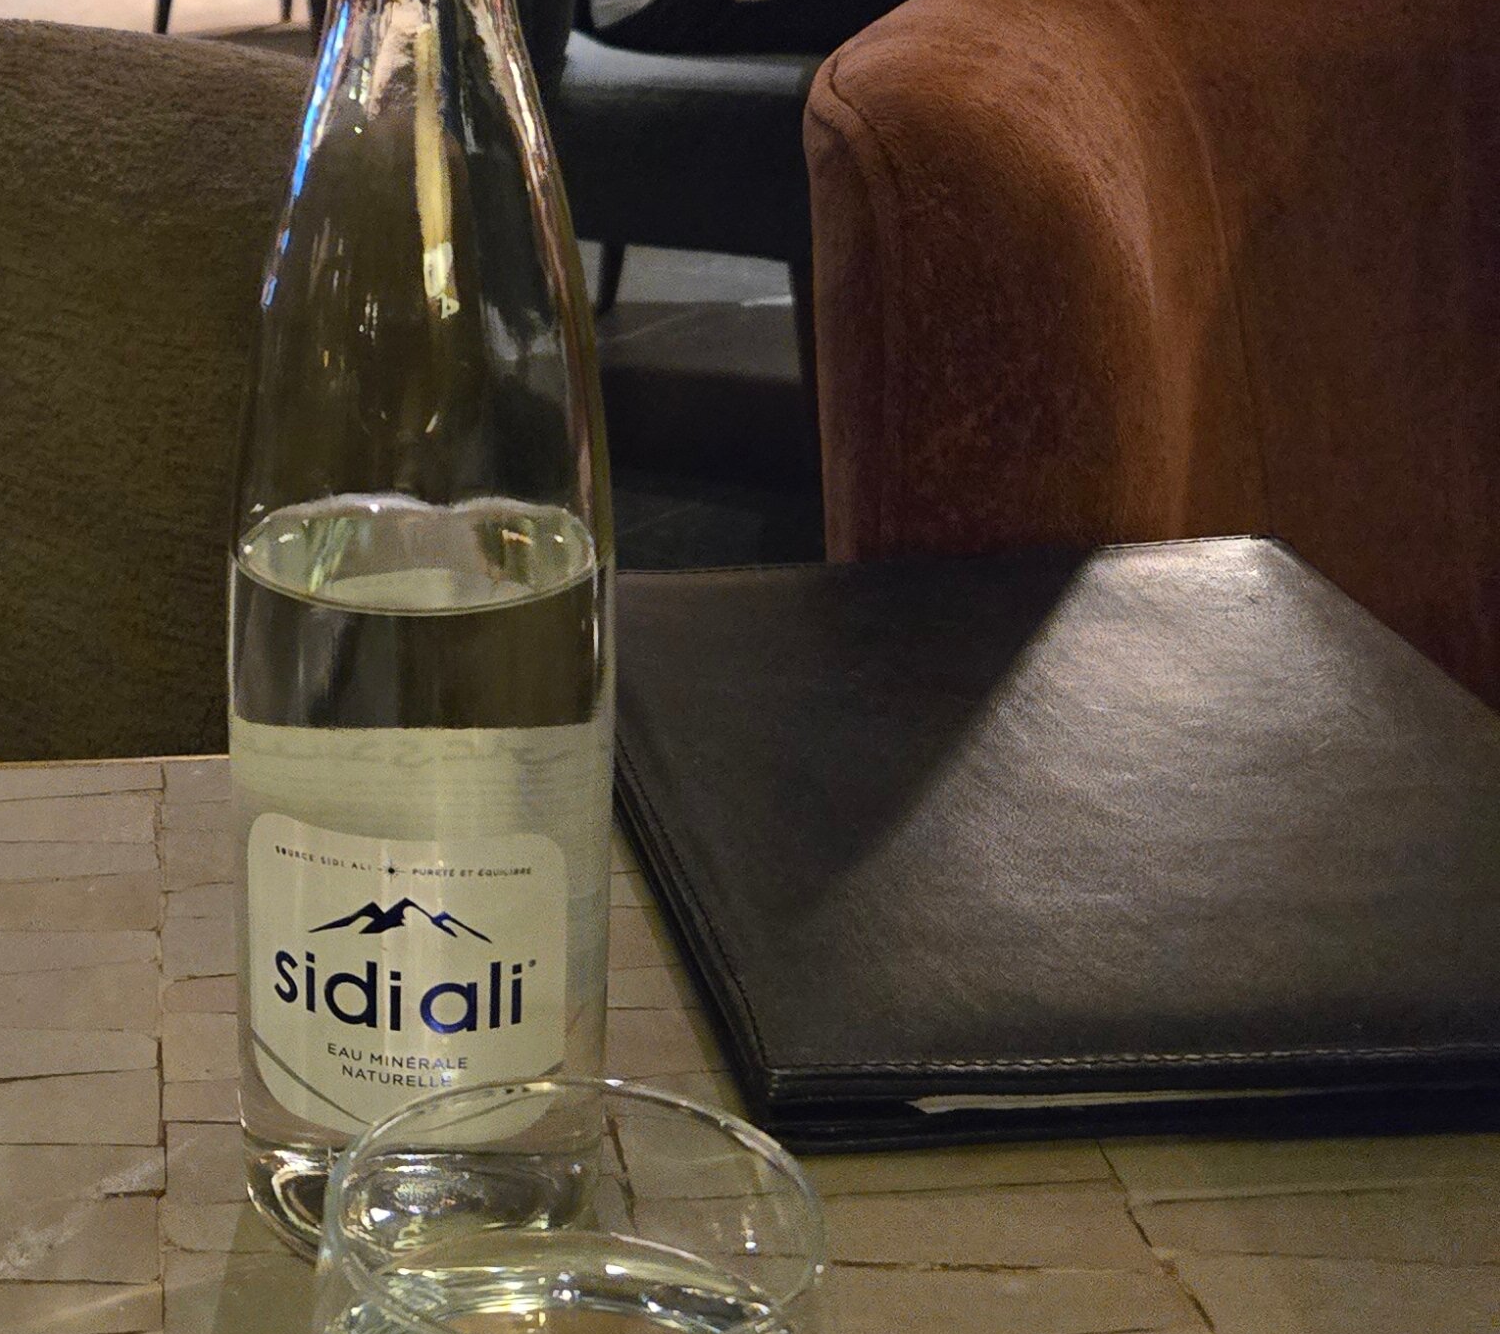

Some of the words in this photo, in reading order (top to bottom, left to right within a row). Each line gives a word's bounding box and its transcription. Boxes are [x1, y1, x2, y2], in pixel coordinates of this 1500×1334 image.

[274, 949, 402, 1032] sidi
[327, 1042, 362, 1061] EAU
[370, 1052, 468, 1070] MINÉRALE
[342, 1065, 452, 1087] NATURELLE
